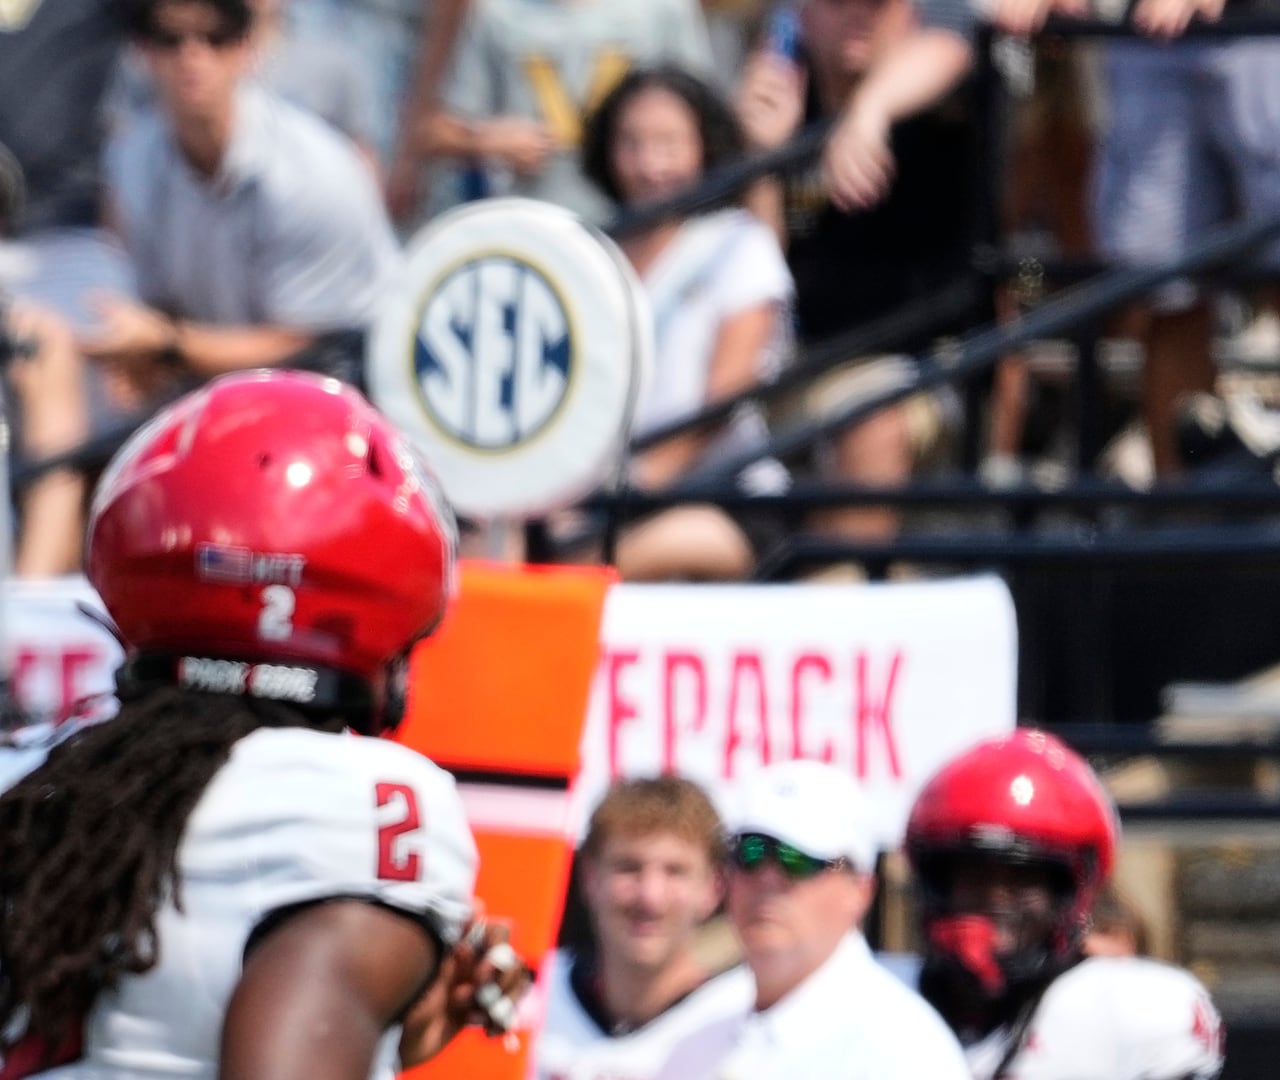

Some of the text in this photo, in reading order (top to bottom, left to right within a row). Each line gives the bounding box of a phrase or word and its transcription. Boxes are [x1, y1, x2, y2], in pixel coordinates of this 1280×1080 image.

[416, 260, 572, 447] SEC
[255, 584, 297, 642] 2
[373, 782, 422, 882] 2
